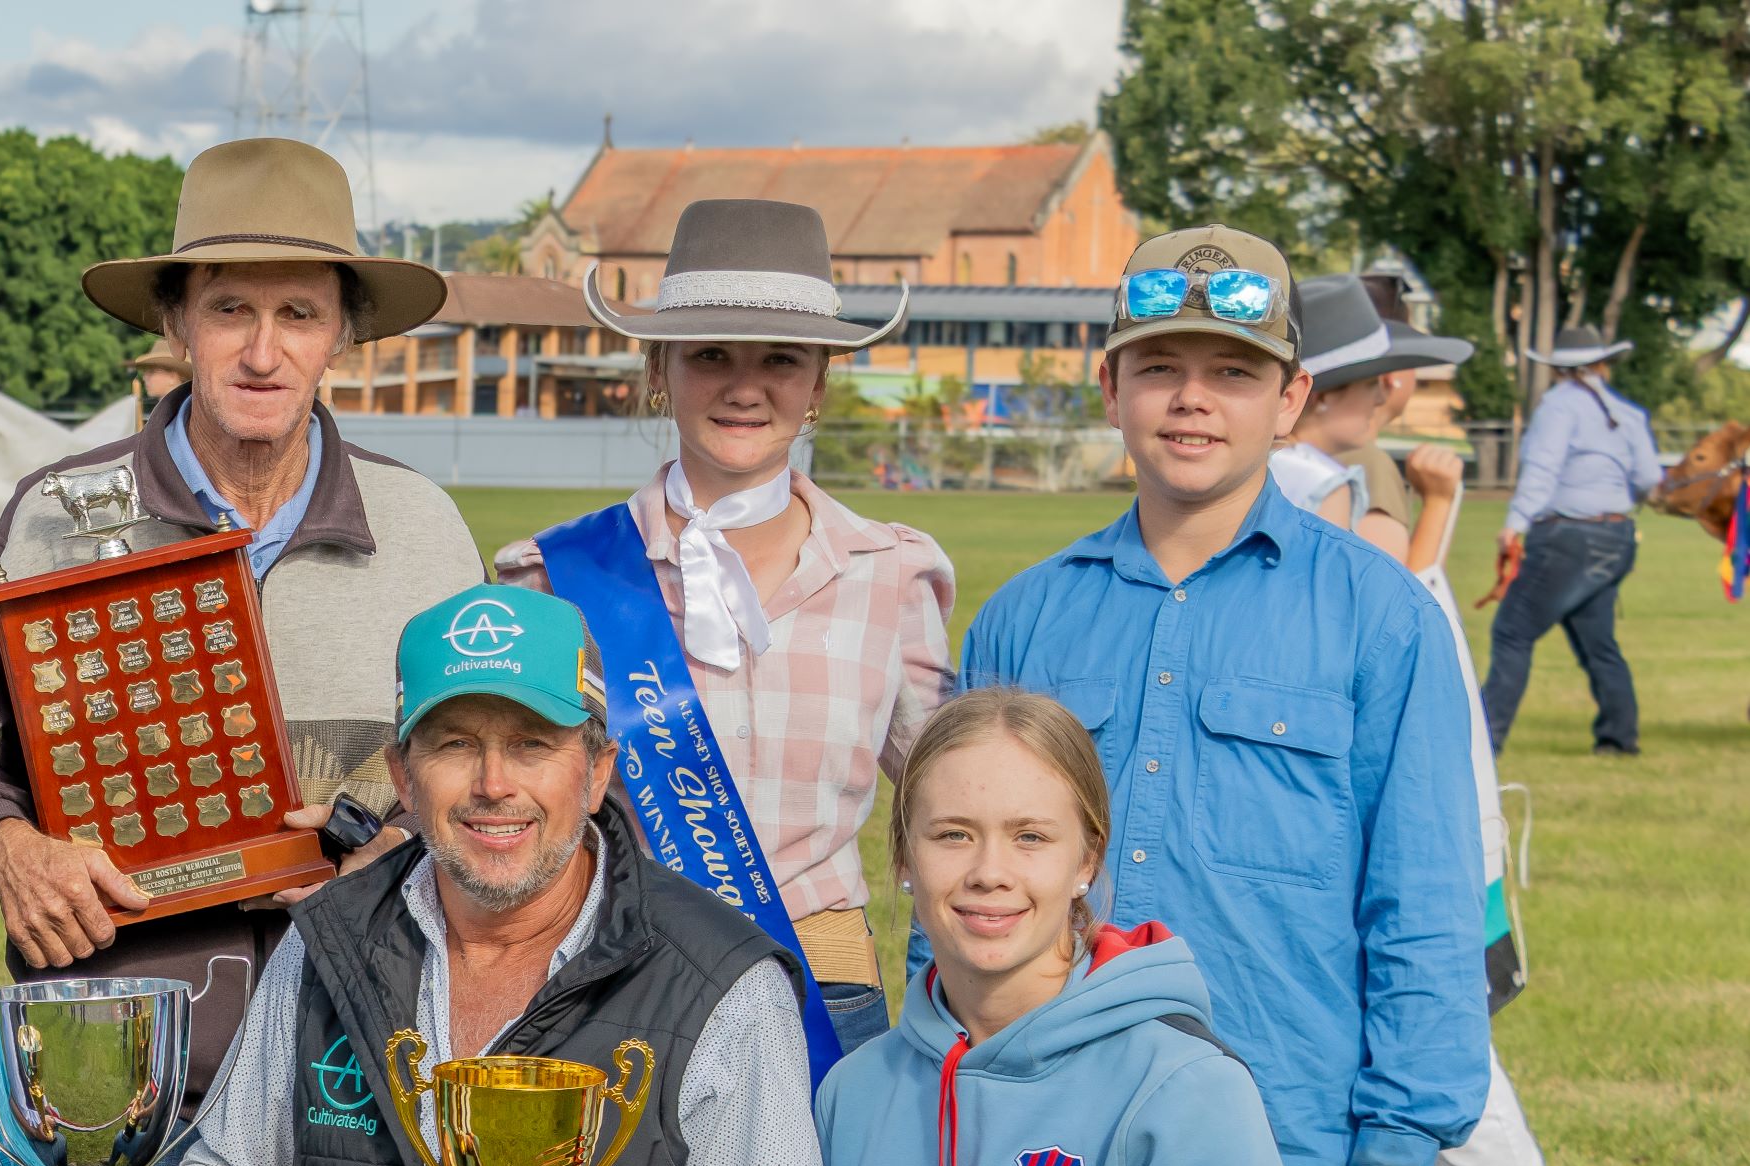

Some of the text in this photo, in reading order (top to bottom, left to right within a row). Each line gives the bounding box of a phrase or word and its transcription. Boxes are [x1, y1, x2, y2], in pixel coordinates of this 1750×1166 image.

[444, 658, 522, 676] CultivateAg
[629, 660, 756, 922] Teen Showg
[678, 699, 771, 905] KEMPSEY SHOW SOCIETY 2025
[637, 785, 684, 873] WINNER
[138, 857, 221, 882] LEO ROSTEN MEMORIAL
[178, 875, 190, 883] FAT
[191, 869, 213, 880] CATTLE
[307, 1106, 377, 1136] CultivateAg
